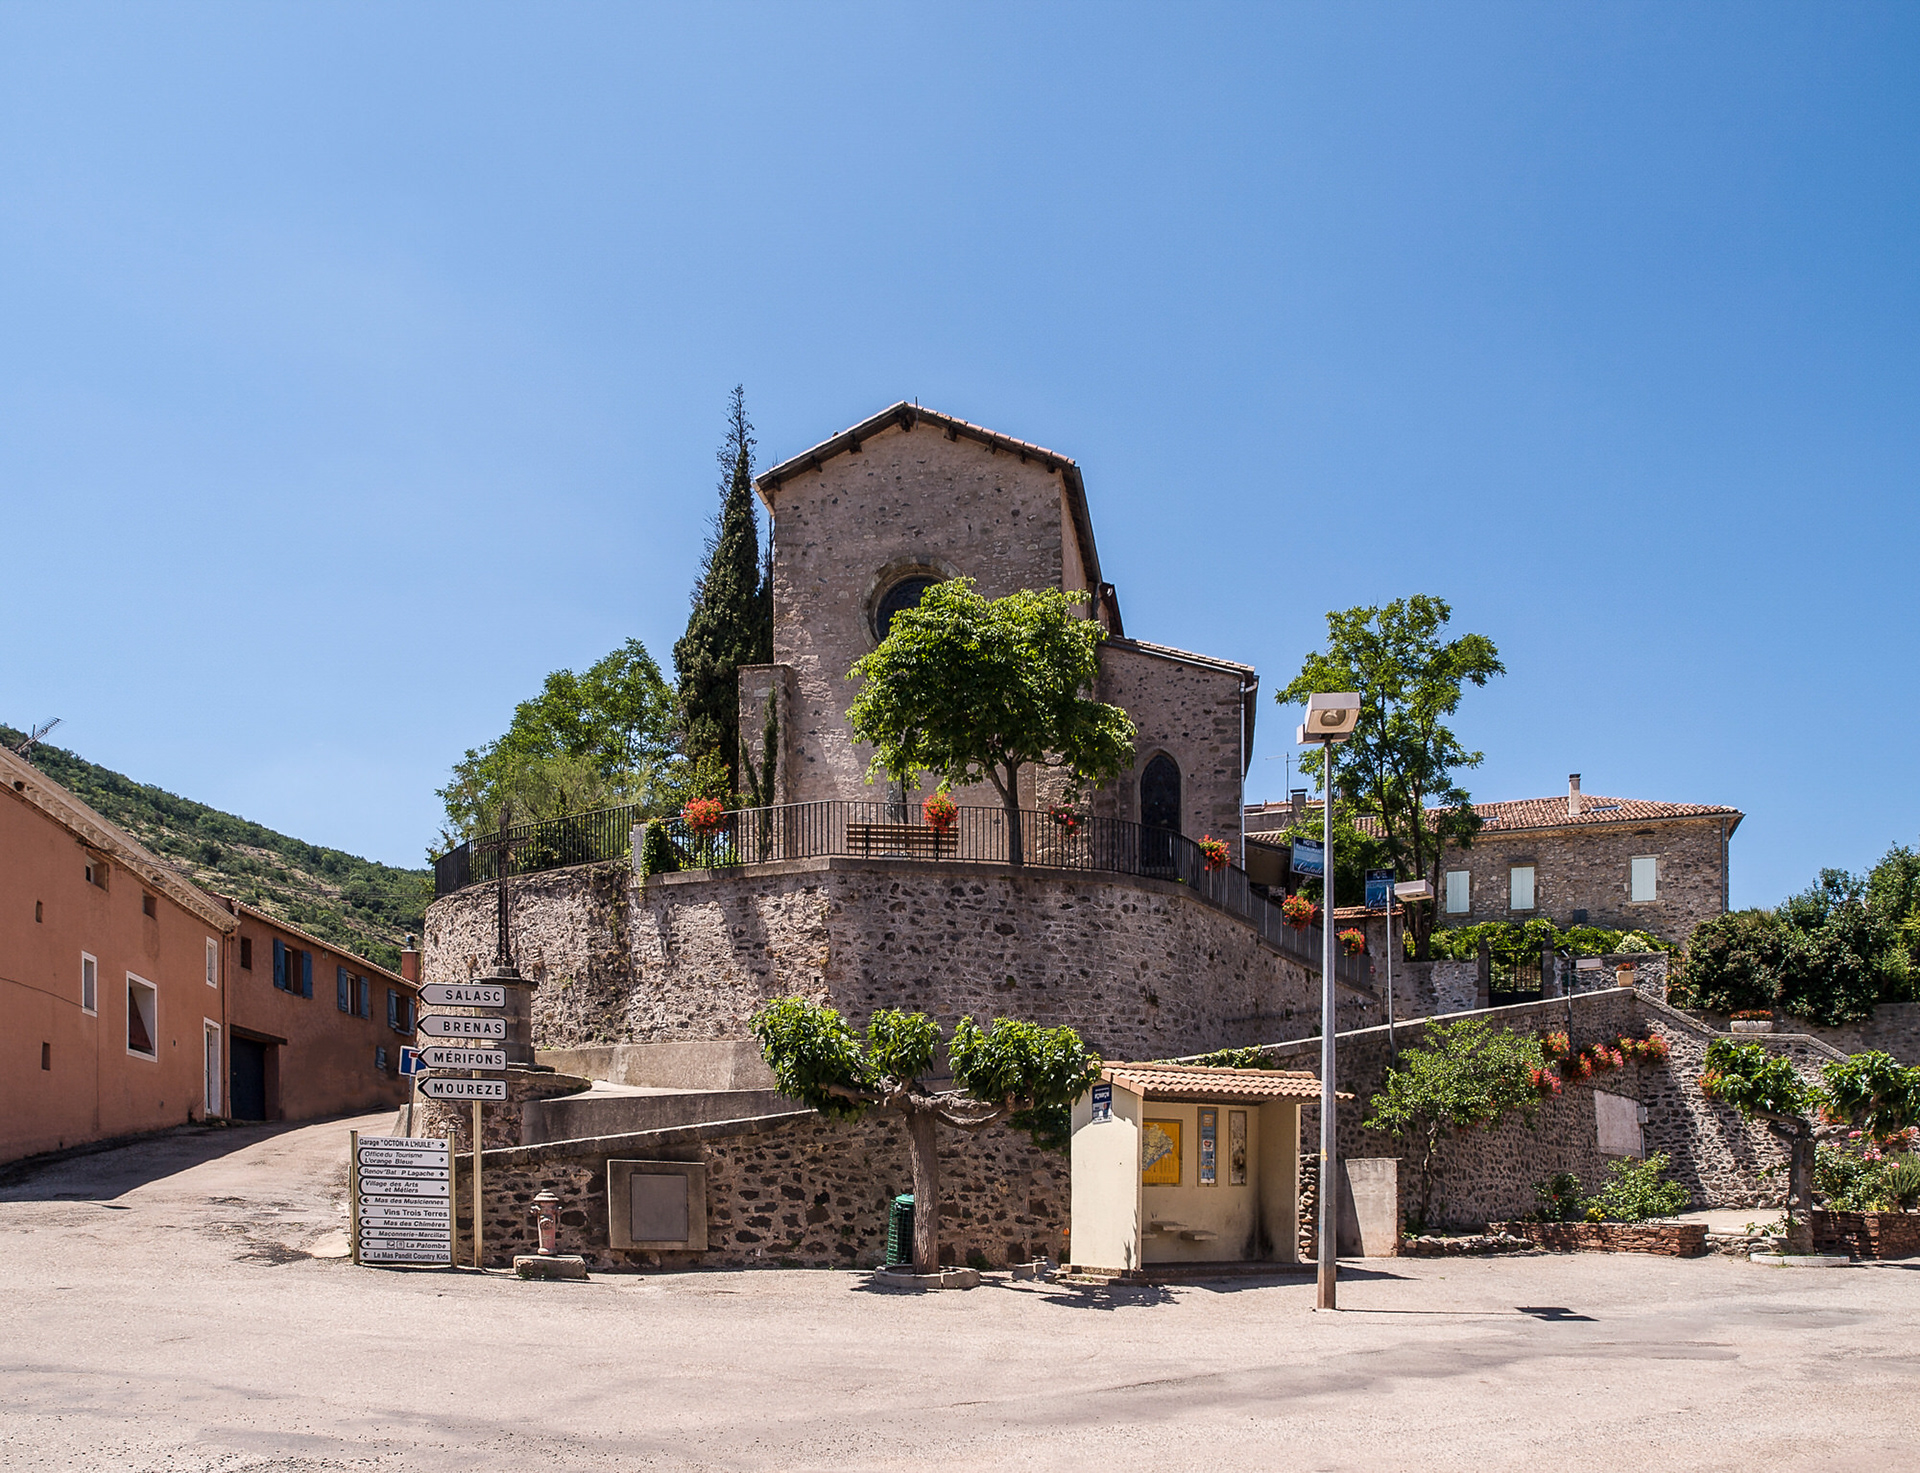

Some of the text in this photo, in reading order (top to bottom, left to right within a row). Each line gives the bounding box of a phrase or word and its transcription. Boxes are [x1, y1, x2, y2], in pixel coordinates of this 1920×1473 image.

[1302, 840, 1317, 848] HOTEL
[445, 990, 500, 1001] SALASC
[443, 1021, 502, 1033] BRENAS
[434, 1051, 502, 1064] MÉRIFONS
[434, 1083, 502, 1095] MOUREZE
[360, 1139, 379, 1147] Garage
[364, 1158, 392, 1166] L'orange
[407, 1170, 435, 1178] Lagache
[365, 1180, 387, 1188] Village
[384, 1208, 448, 1217] Vins Trois Terres
[373, 1251, 381, 1259] Le
[394, 1252, 412, 1260] Pandit
[413, 1252, 435, 1261] Country
